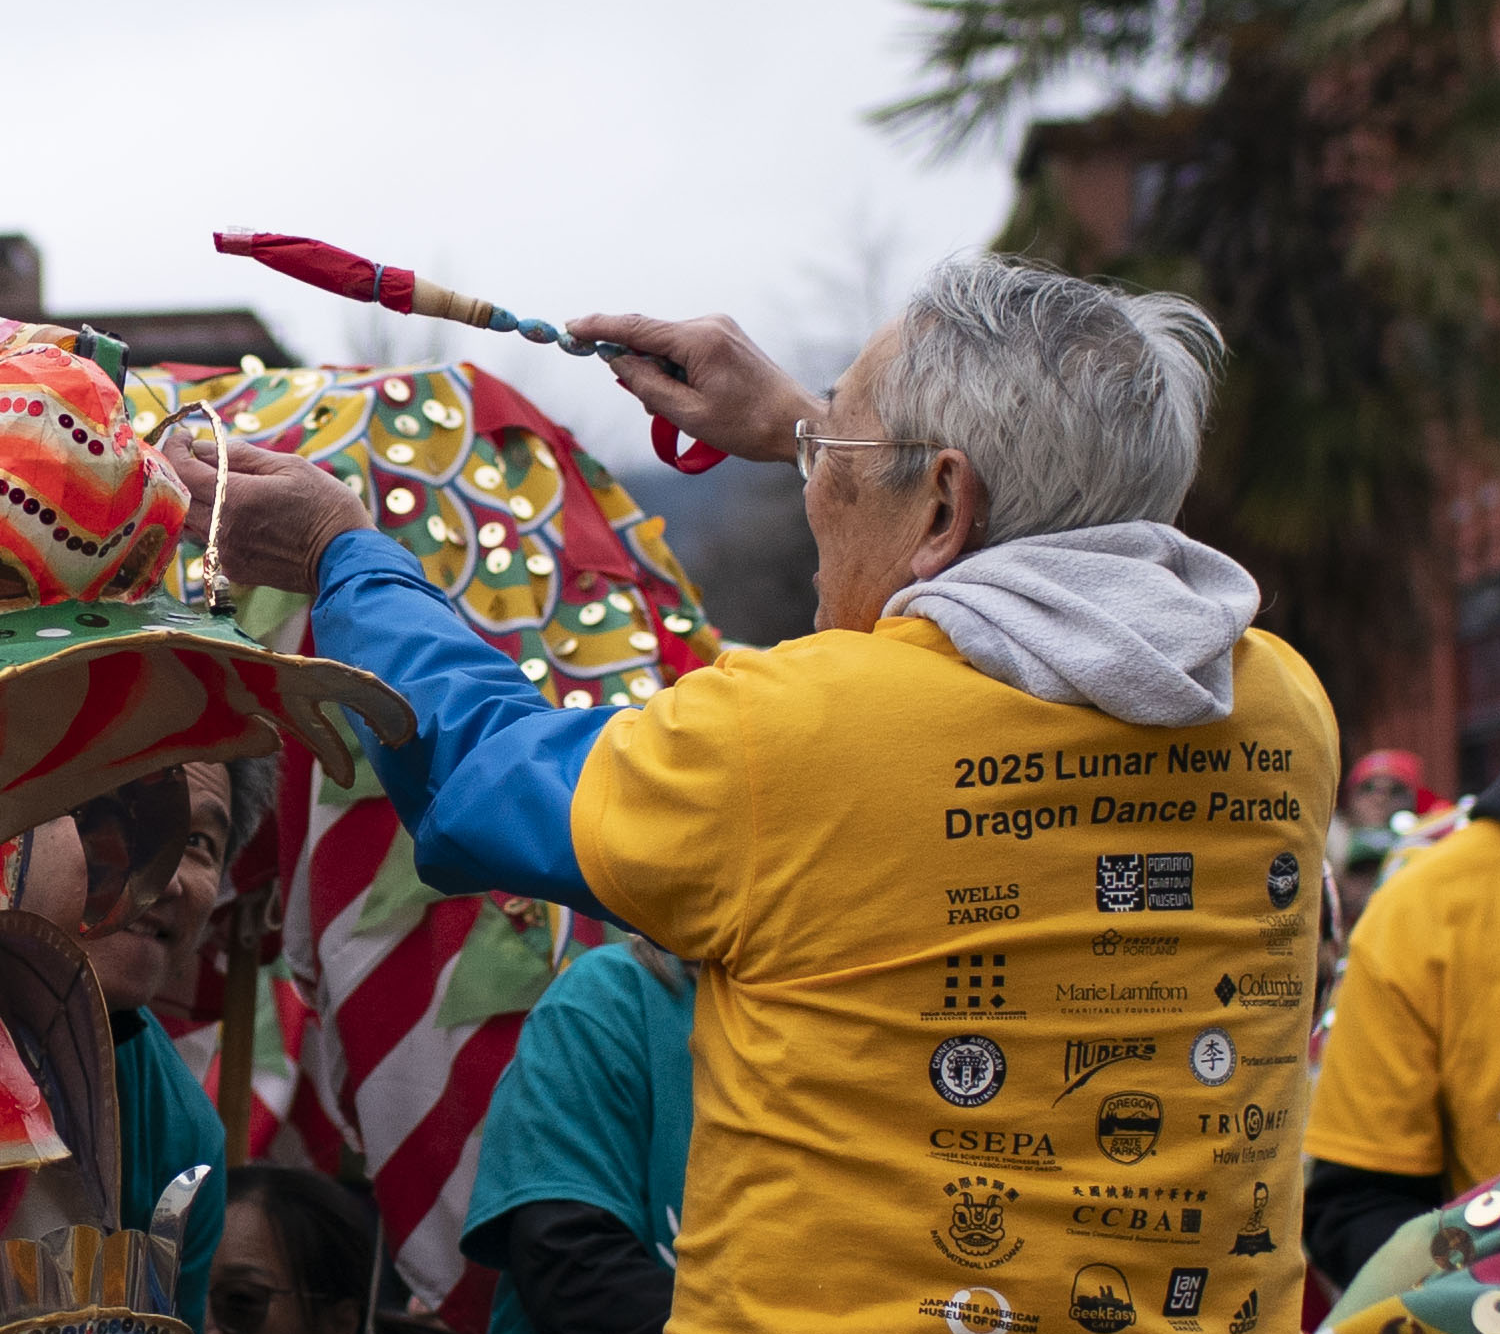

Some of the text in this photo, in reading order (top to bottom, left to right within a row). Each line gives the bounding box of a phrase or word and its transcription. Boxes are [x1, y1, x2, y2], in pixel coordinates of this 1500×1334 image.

[954, 740, 1293, 789] 2025 Lunar New Year
[944, 791, 1300, 841] Dragon Dance Parade
[945, 883, 1020, 905] WELLS
[1148, 893, 1192, 907] MUSEUM
[947, 904, 1020, 925] FARGO
[1123, 946, 1177, 955] PORTLAND
[1124, 936, 1180, 946] PROSPER
[1055, 981, 1188, 1001] Marie Lamfrom
[932, 1036, 1004, 1071] CHINESE AMERICAN
[1201, 1039, 1225, 1071] 李
[936, 1078, 999, 1106] CITIZENS ALLIANCE
[1107, 1097, 1155, 1112] OREGON
[930, 1128, 1056, 1157] CSEPA
[1110, 1146, 1142, 1156] PARKS
[1111, 1137, 1142, 1147] STATE
[1213, 1148, 1240, 1164] How
[1072, 1205, 1172, 1232] CCBA
[930, 1229, 1025, 1270] INTERNATIONAL LION DANCE
[918, 1307, 1038, 1334] MUSEUM OF OREGON
[920, 1298, 1040, 1323] JAPANESE AMERICAN
[1070, 1305, 1136, 1323] GeekEasy
